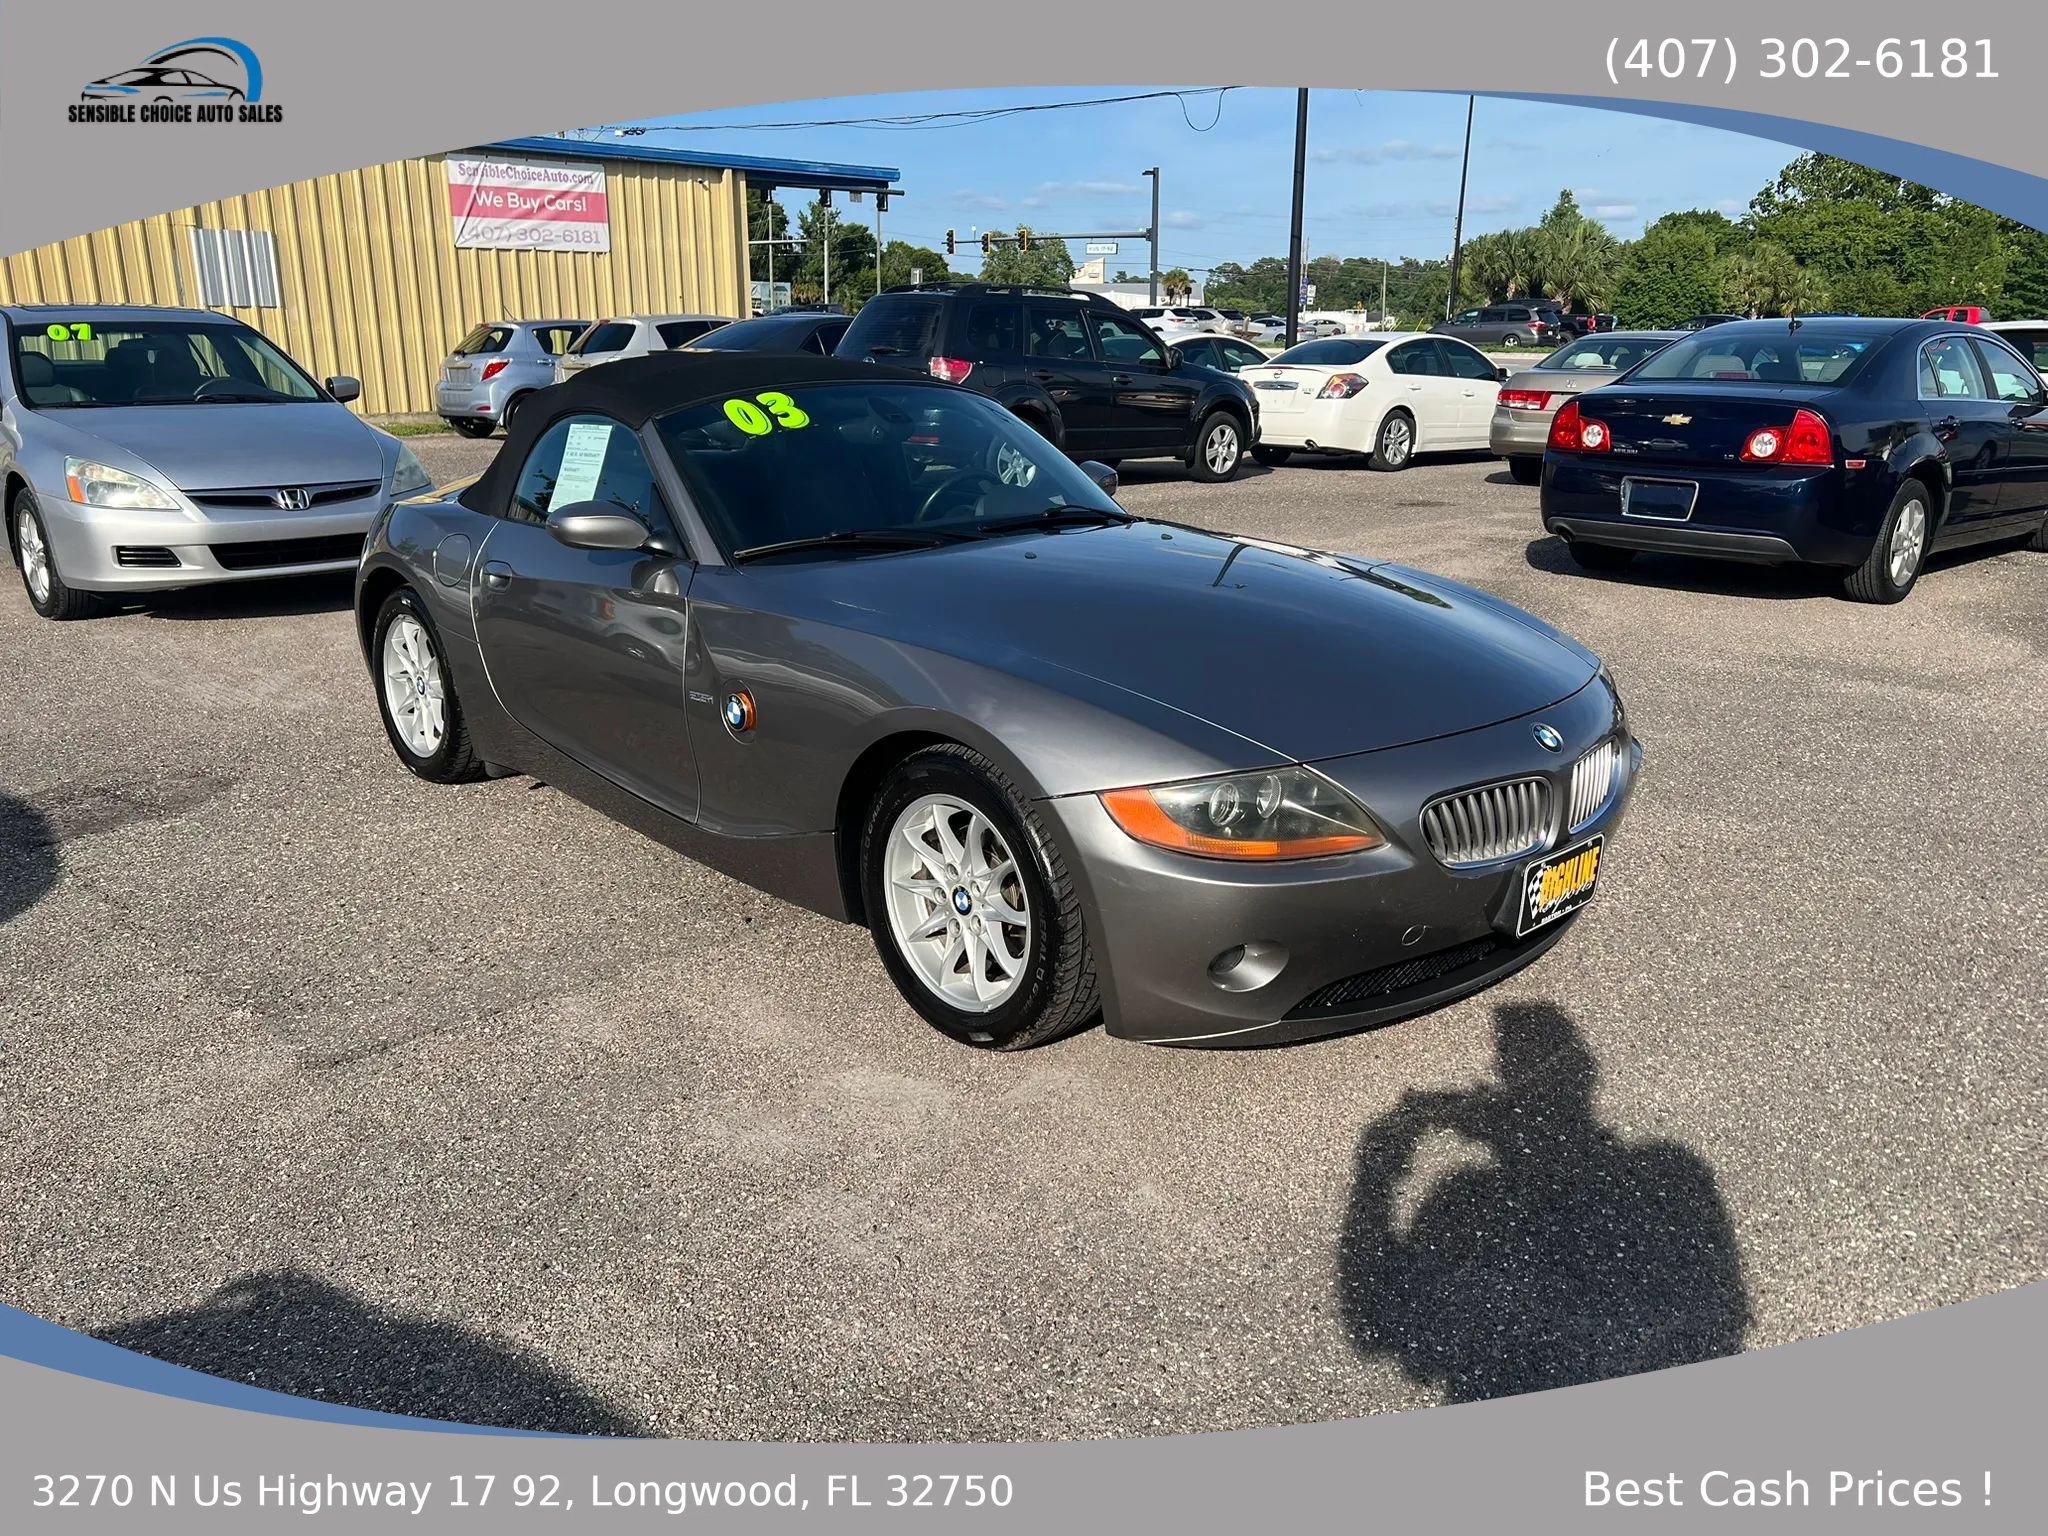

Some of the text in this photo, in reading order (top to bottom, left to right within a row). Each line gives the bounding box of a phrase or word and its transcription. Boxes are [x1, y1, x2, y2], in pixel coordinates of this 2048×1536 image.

[475, 191, 587, 213] We Buy Cars!
[516, 227, 600, 244] 302-6181
[46, 323, 92, 341] 07
[723, 392, 810, 436] 03
